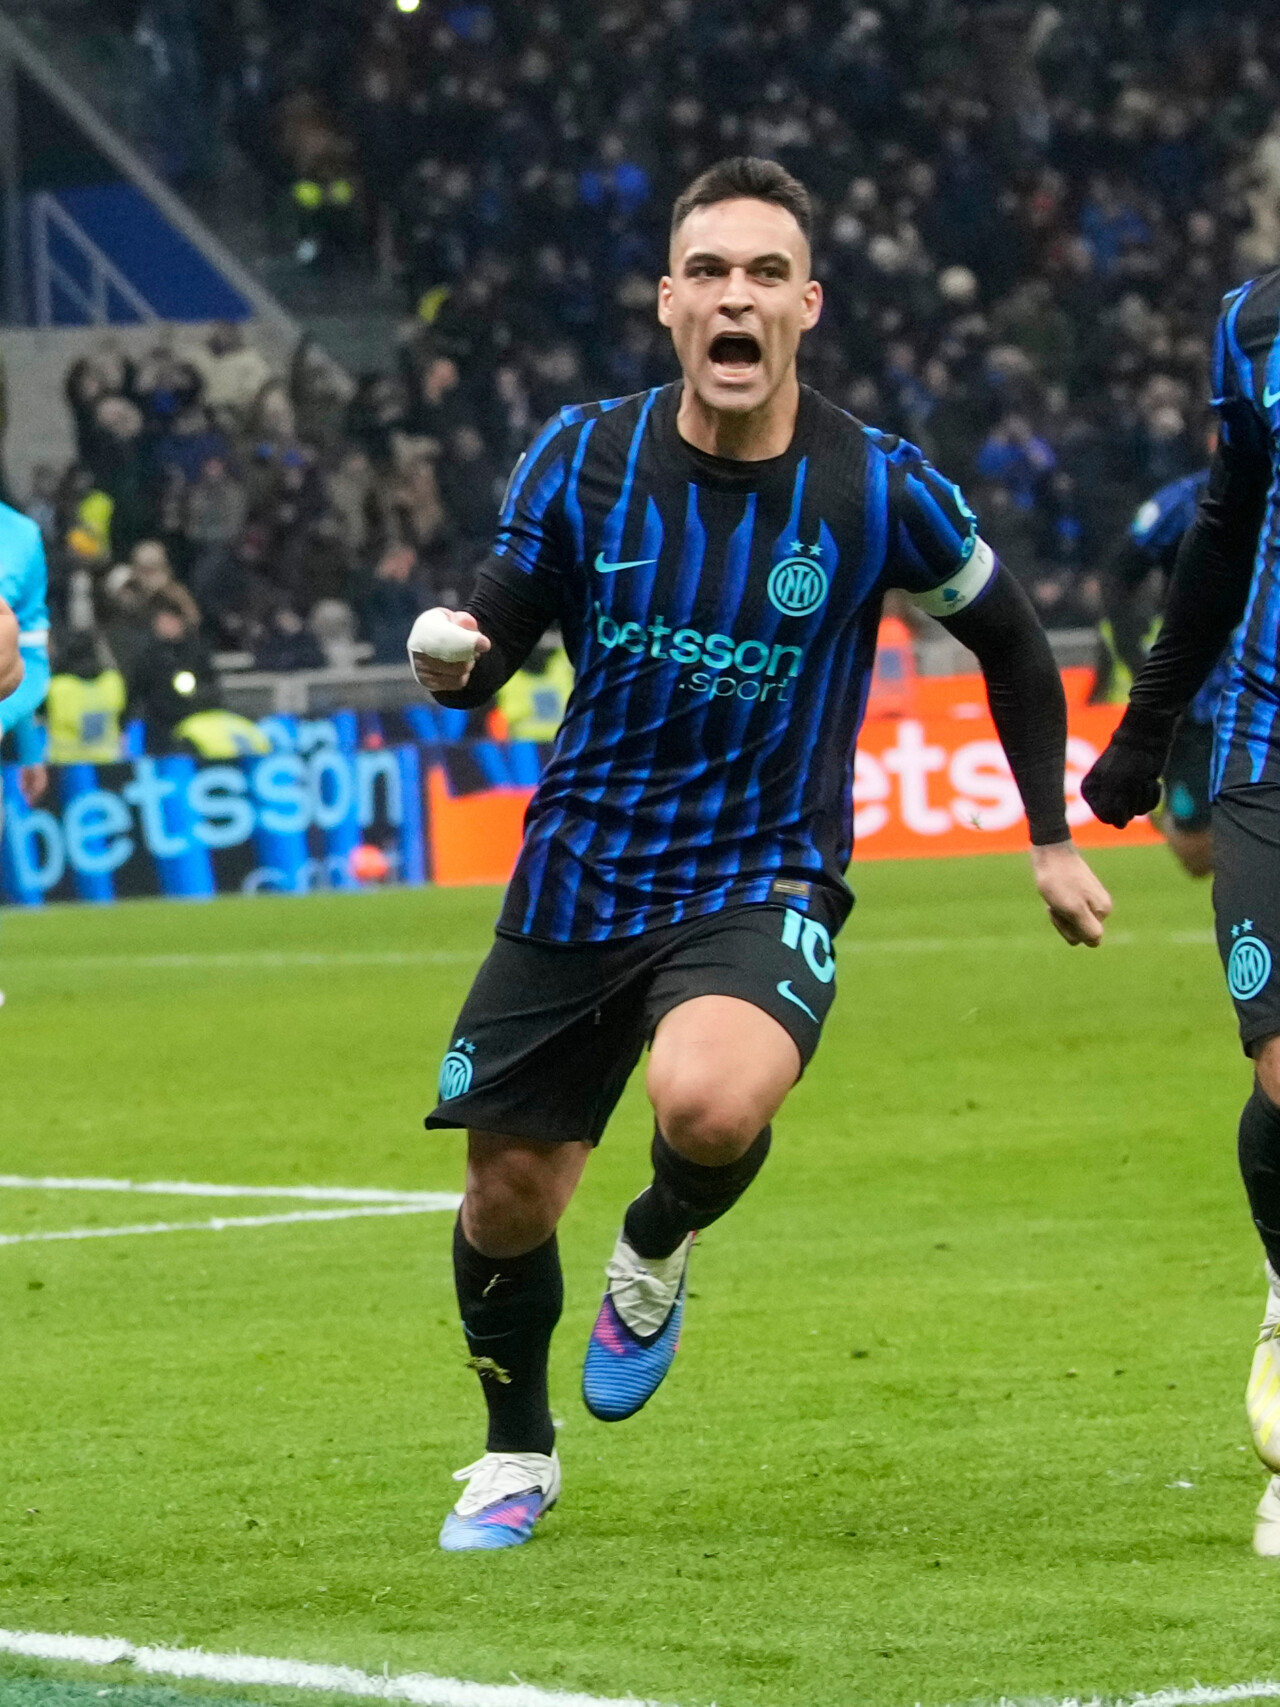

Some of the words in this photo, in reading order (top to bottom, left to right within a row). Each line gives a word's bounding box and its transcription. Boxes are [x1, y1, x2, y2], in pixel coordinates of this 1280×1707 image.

[594, 600, 803, 677] betsson
[679, 672, 789, 701] .sport
[7, 747, 403, 889] betsson
[781, 908, 836, 983] 10
